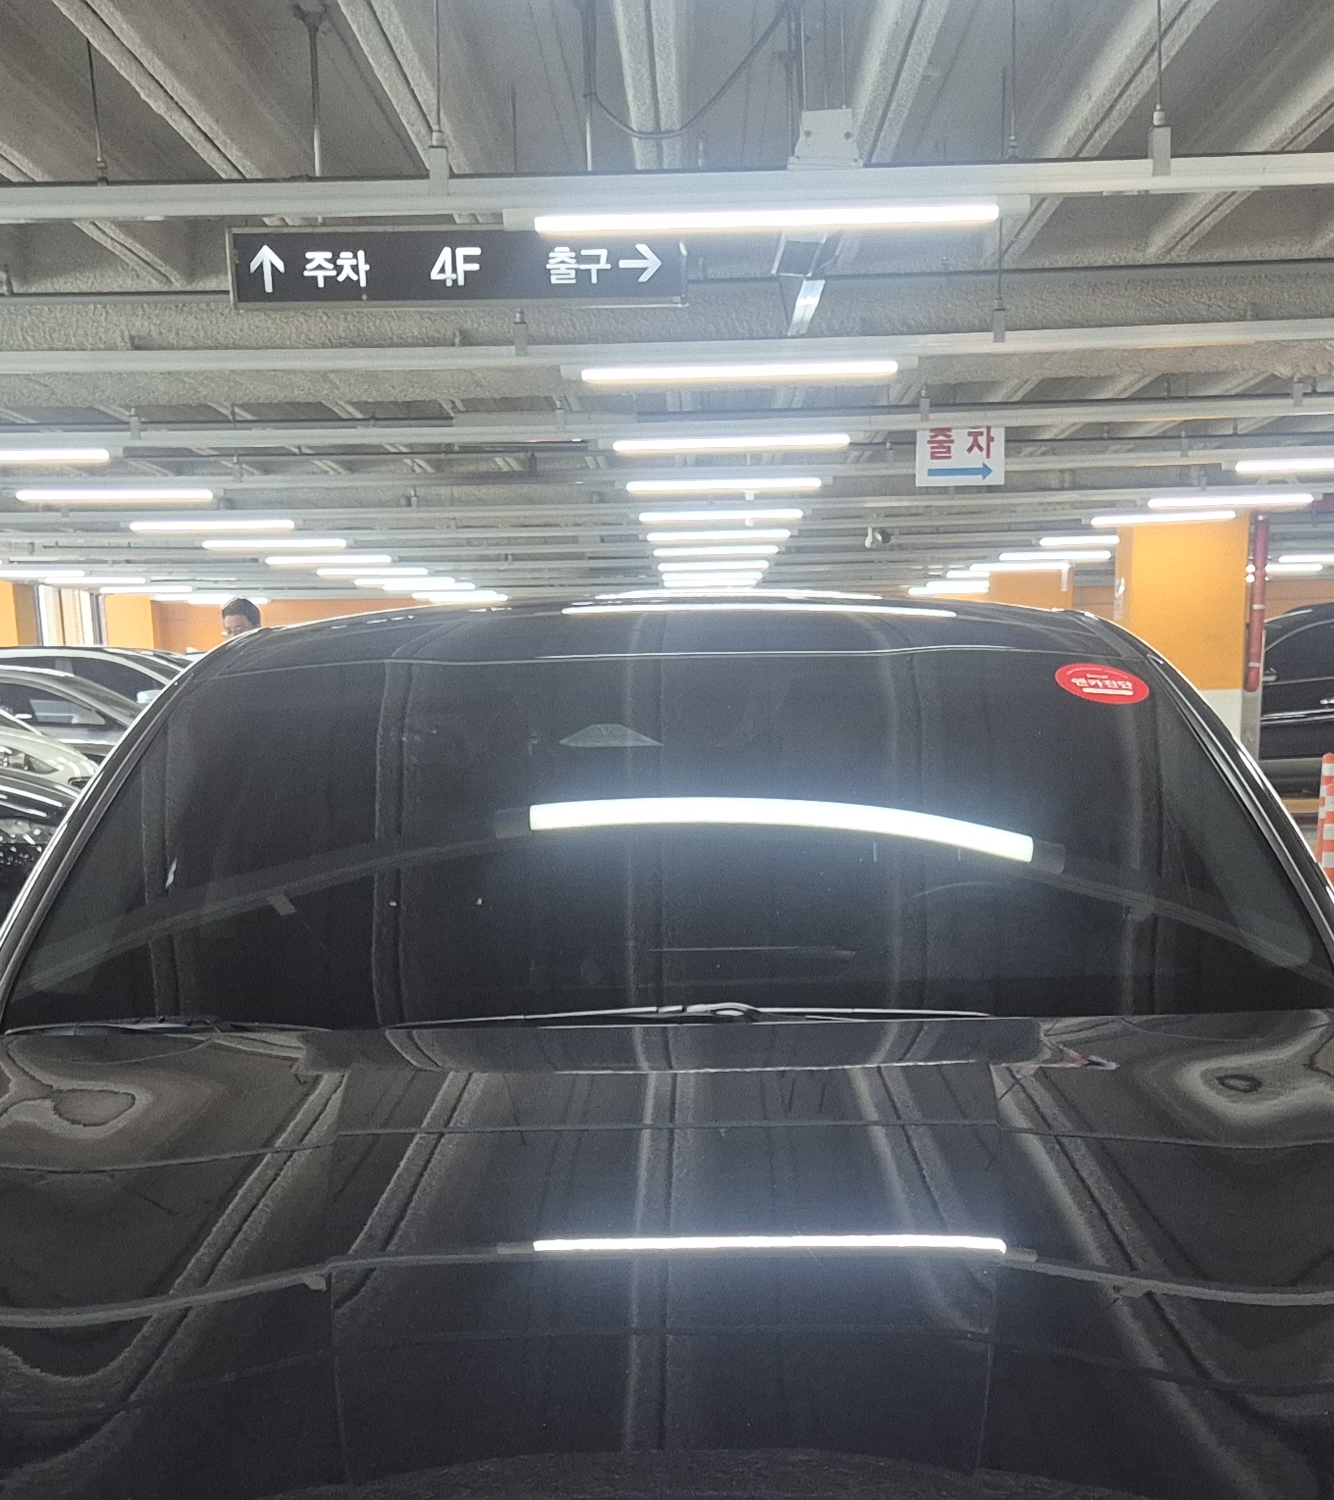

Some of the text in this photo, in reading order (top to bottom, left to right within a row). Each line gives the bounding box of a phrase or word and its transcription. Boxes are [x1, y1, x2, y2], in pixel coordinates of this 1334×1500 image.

[303, 247, 612, 288] 주차 4F 출구
